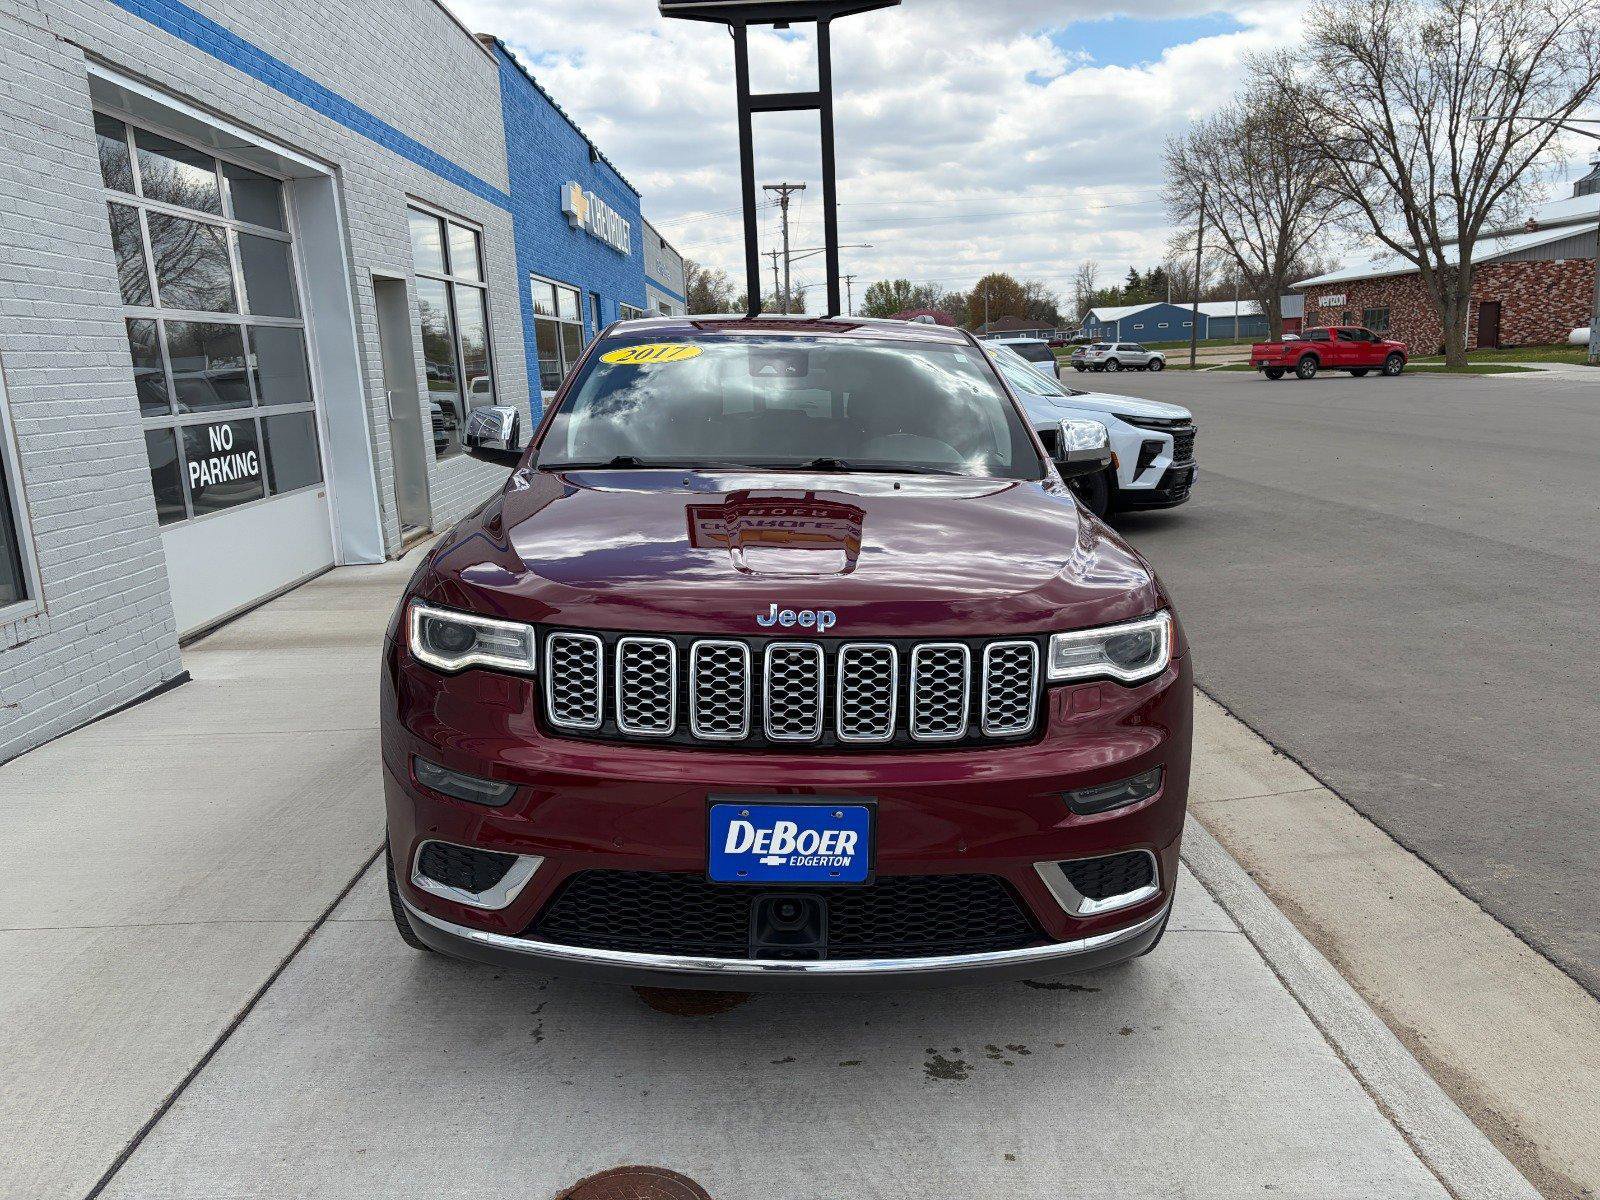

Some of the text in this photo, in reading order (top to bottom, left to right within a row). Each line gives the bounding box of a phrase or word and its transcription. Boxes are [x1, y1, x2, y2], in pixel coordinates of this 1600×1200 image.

[584, 191, 631, 255] CHEVROLET
[1318, 293, 1347, 308] verizon
[616, 346, 689, 362] 2017
[208, 424, 233, 453] NO
[188, 450, 259, 489] PARKING
[756, 603, 837, 633] Jeep
[789, 855, 852, 867] EDGERTON
